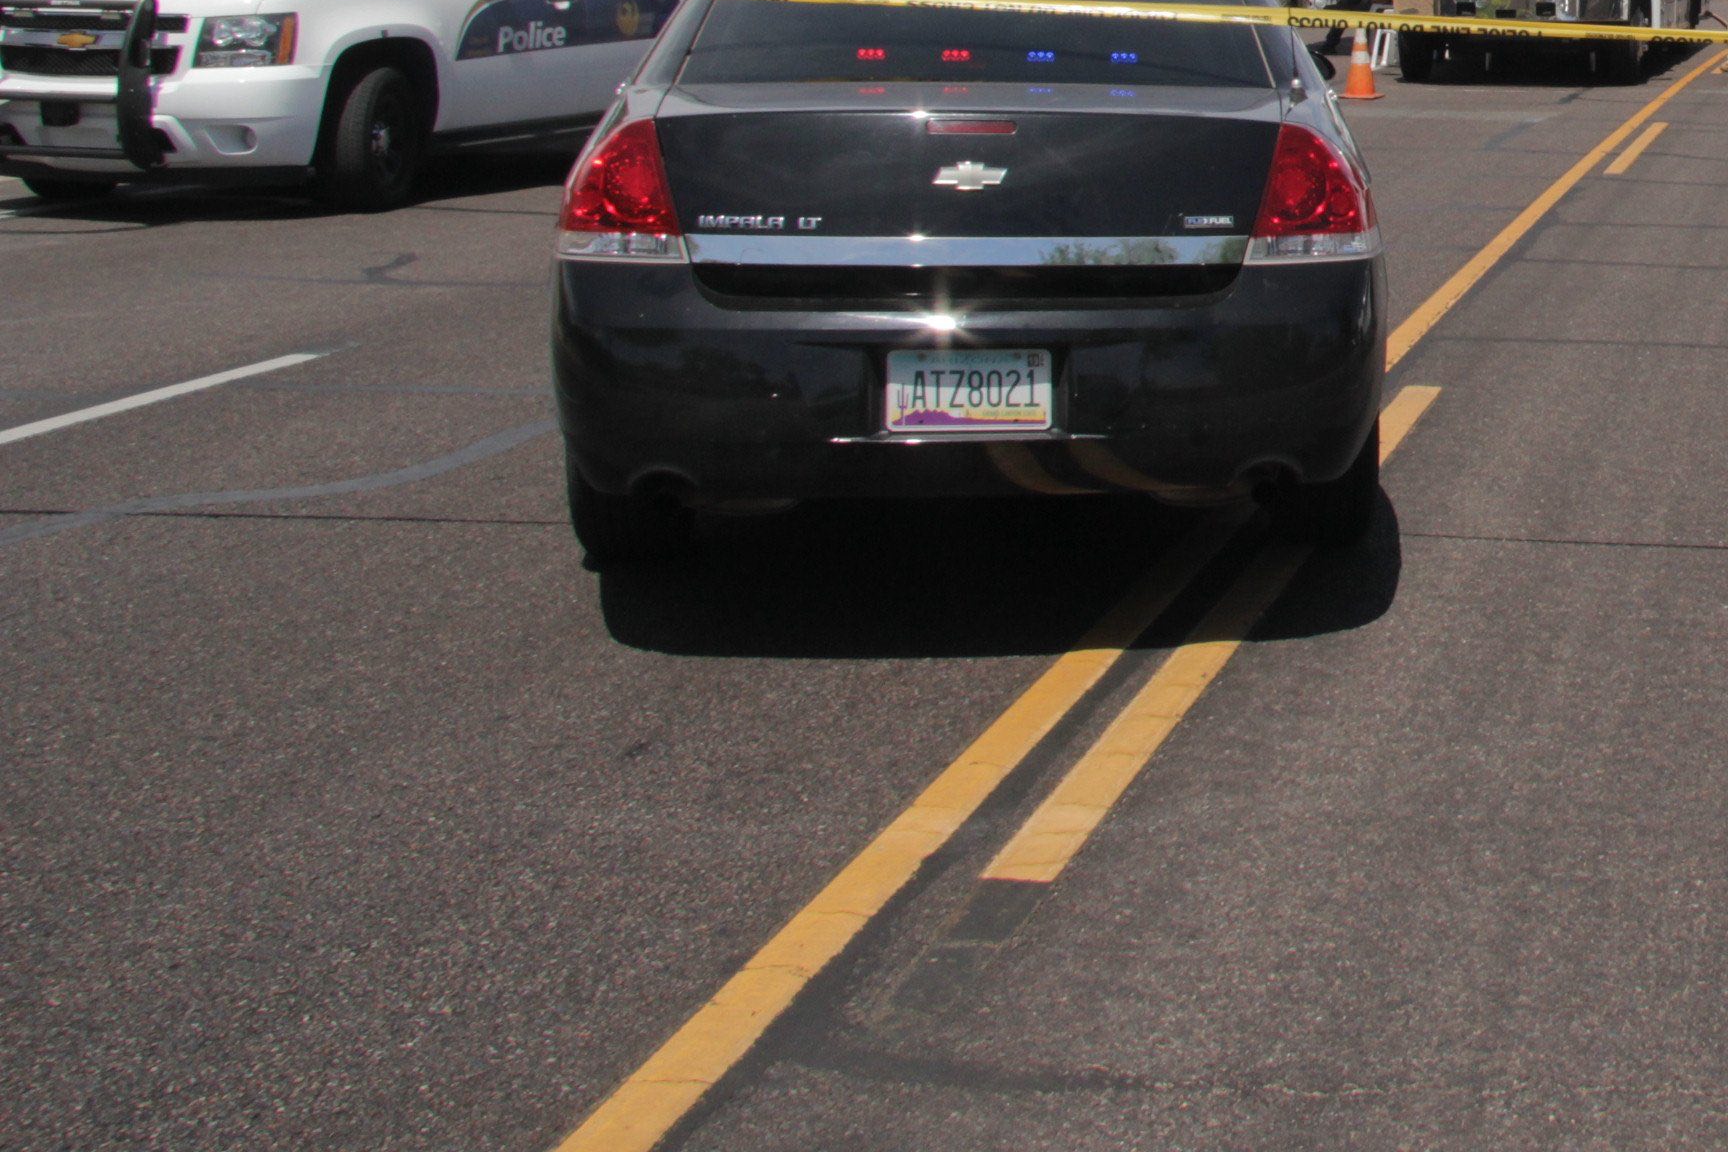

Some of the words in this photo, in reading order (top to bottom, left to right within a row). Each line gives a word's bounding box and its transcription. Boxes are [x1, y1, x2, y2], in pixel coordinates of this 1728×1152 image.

[497, 21, 567, 53] Police
[697, 214, 785, 229] IMPALA
[797, 216, 823, 229] LT
[910, 369, 1041, 409] ATZ8021
